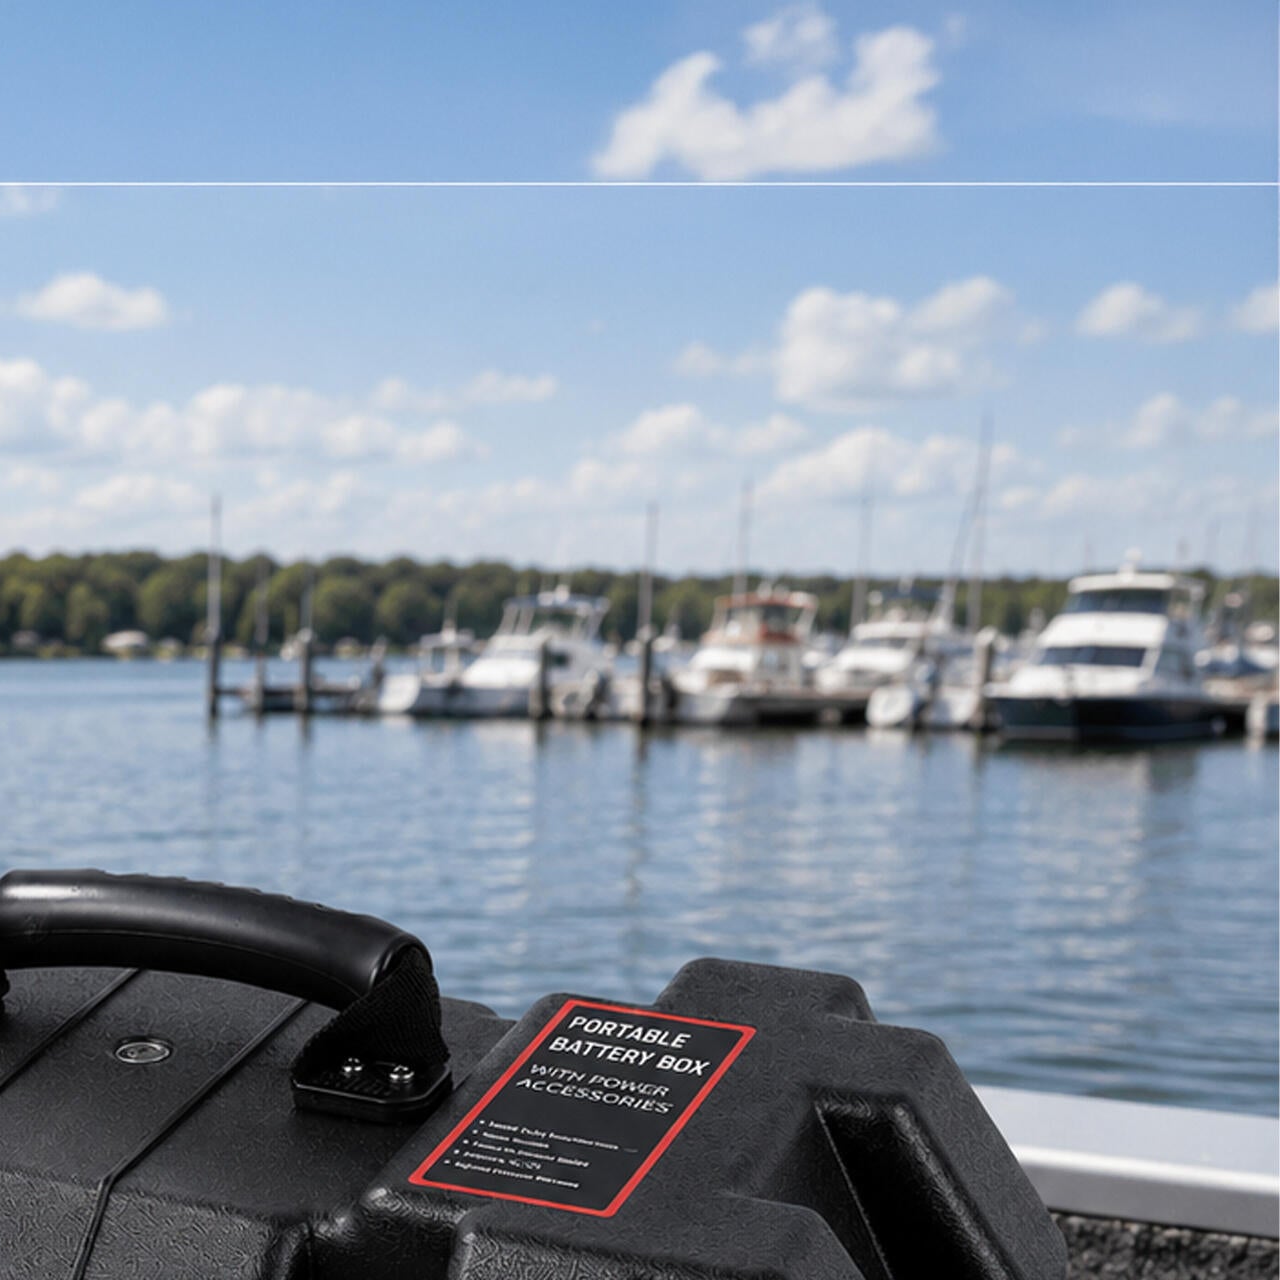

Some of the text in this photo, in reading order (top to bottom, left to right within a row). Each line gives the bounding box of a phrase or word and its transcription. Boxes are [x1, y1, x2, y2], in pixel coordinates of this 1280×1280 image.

[568, 1015, 692, 1049] PORTABLE
[548, 1036, 711, 1077] BATTERY BOX
[515, 1077, 674, 1115] ACCESSORIES
[588, 1074, 670, 1098] POWER
